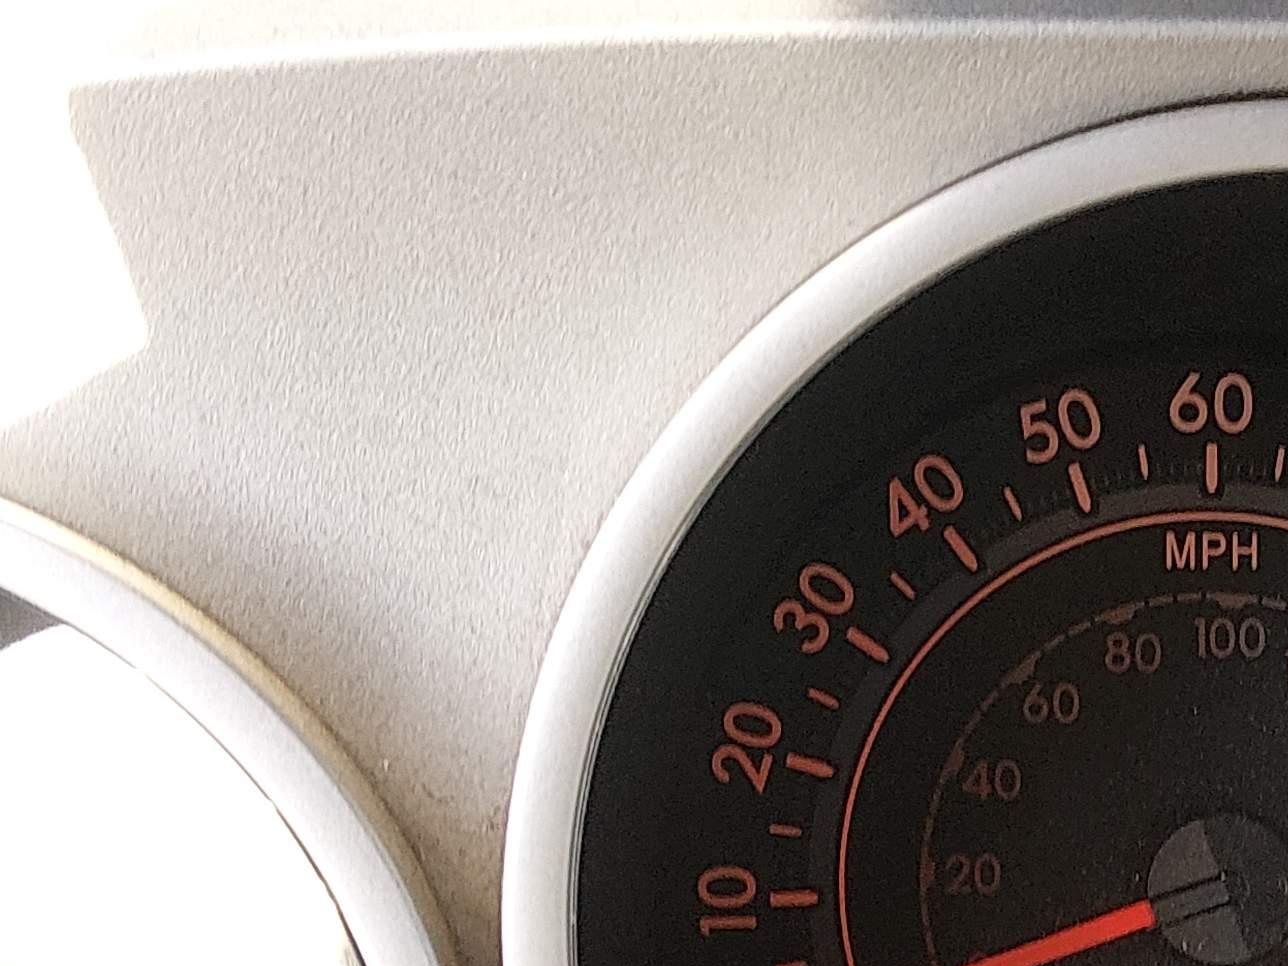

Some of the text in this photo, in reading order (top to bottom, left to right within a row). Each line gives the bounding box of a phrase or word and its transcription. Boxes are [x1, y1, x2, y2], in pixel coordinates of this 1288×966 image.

[1019, 387, 1101, 465] 50
[1169, 371, 1253, 434] 60
[888, 453, 964, 538] 40
[1165, 530, 1259, 572] MPH
[773, 561, 855, 654] 30
[1104, 632, 1162, 674] 80
[1195, 616, 1266, 658] 100
[1022, 682, 1080, 724] 60
[711, 701, 782, 794] 20
[961, 756, 1022, 801] 40
[945, 852, 1001, 895] 20
[697, 865, 758, 937] 10
